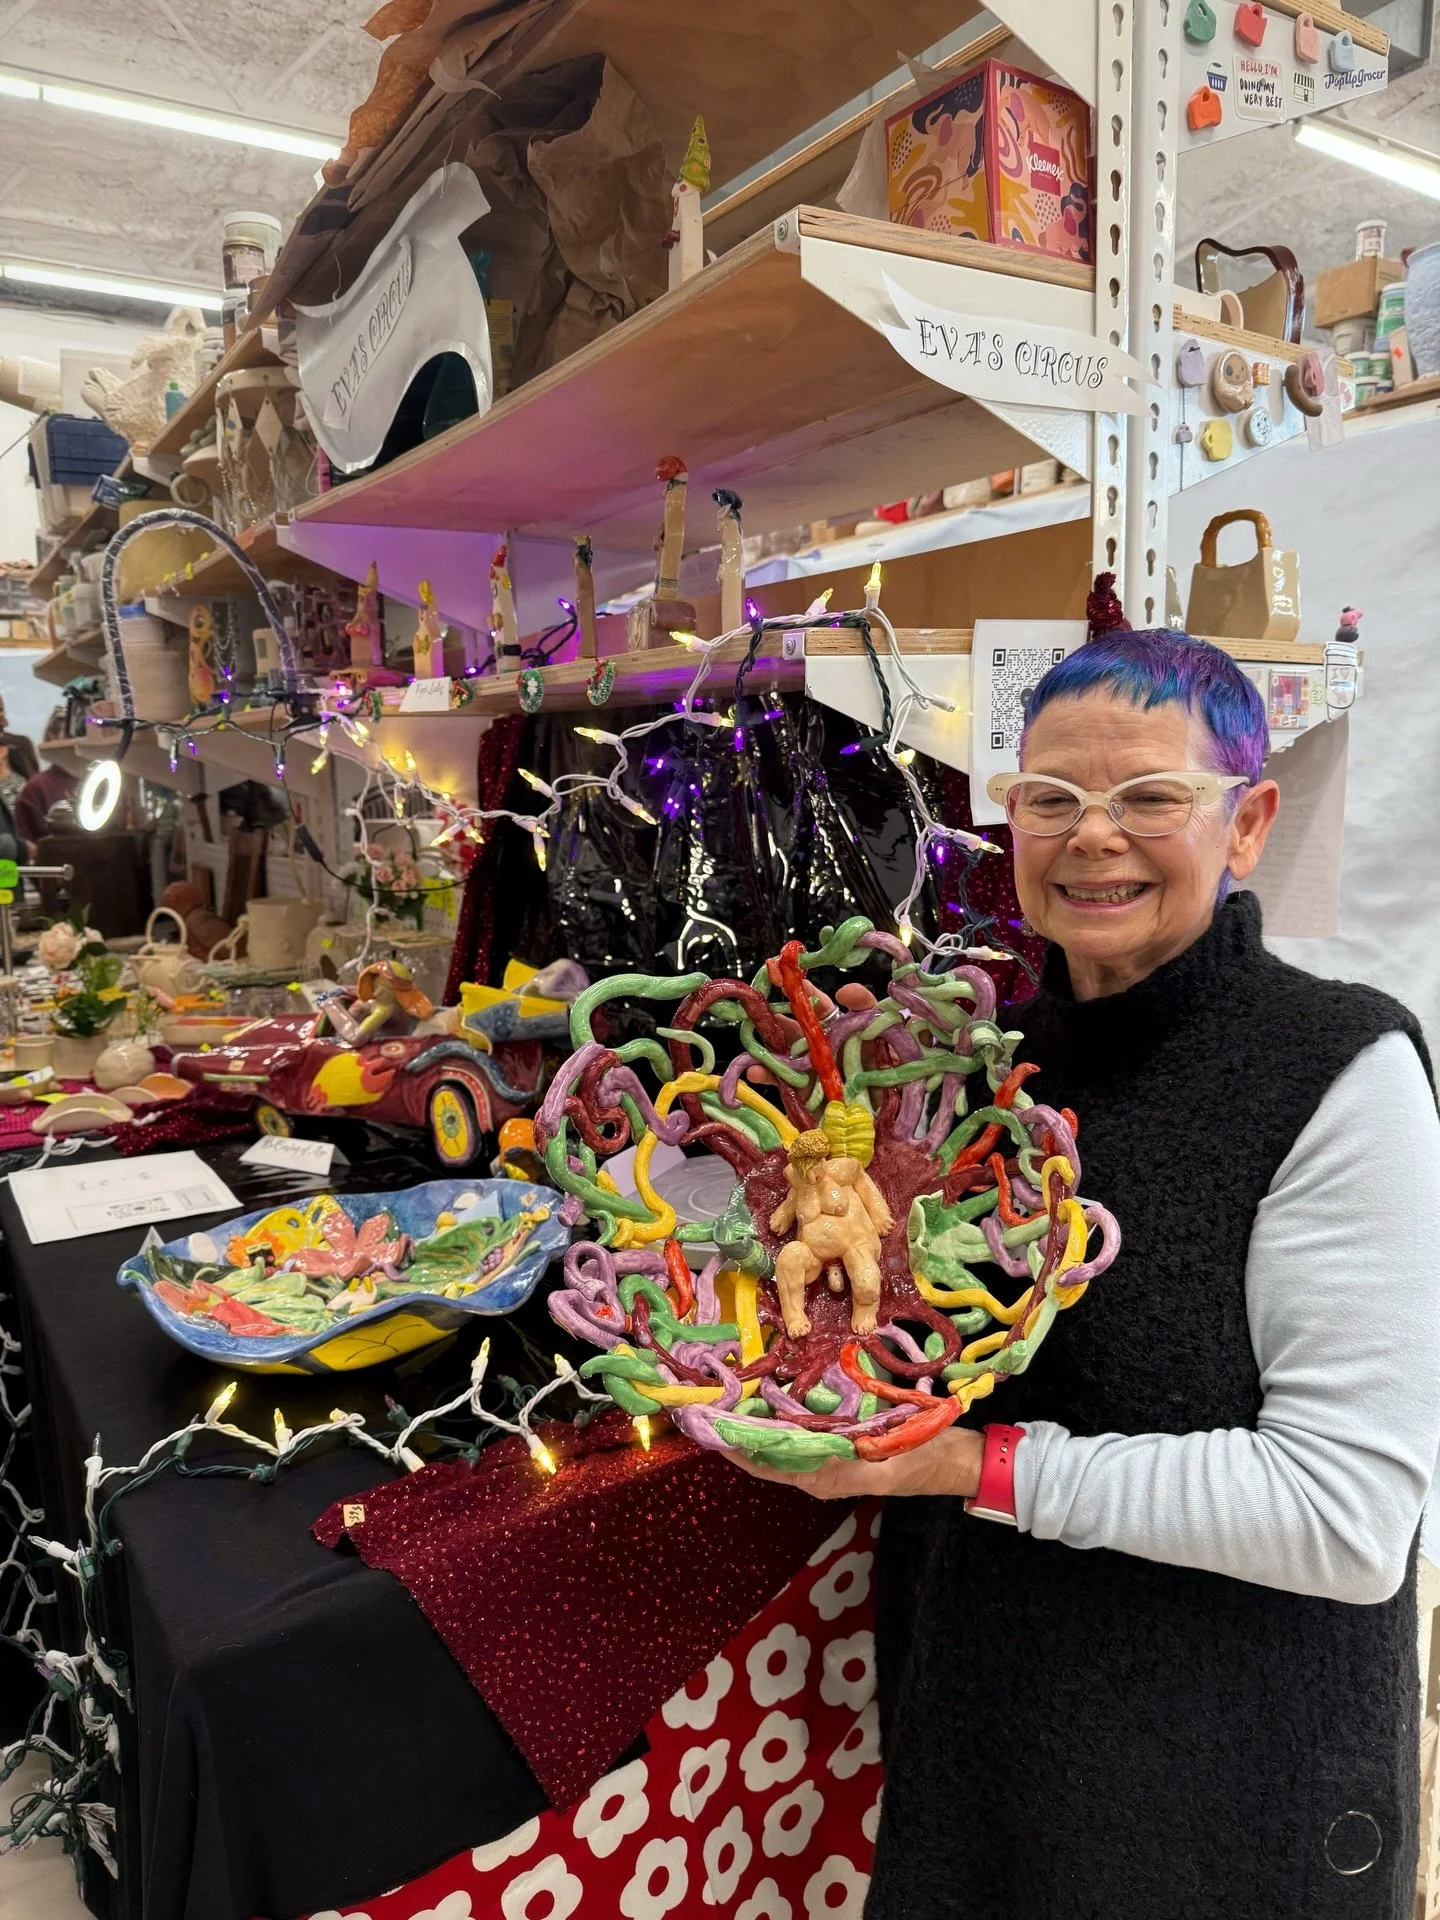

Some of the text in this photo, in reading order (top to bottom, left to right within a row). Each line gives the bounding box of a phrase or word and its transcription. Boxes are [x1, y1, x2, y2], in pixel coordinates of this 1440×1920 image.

[1264, 64, 1278, 76] I'M
[1263, 82, 1275, 95] MY
[1244, 93, 1283, 109] VERY BEST
[1026, 153, 1064, 181] Kleenex
[369, 256, 411, 353] CIRCUS
[915, 315, 1109, 389] EVA'S CIRCUS
